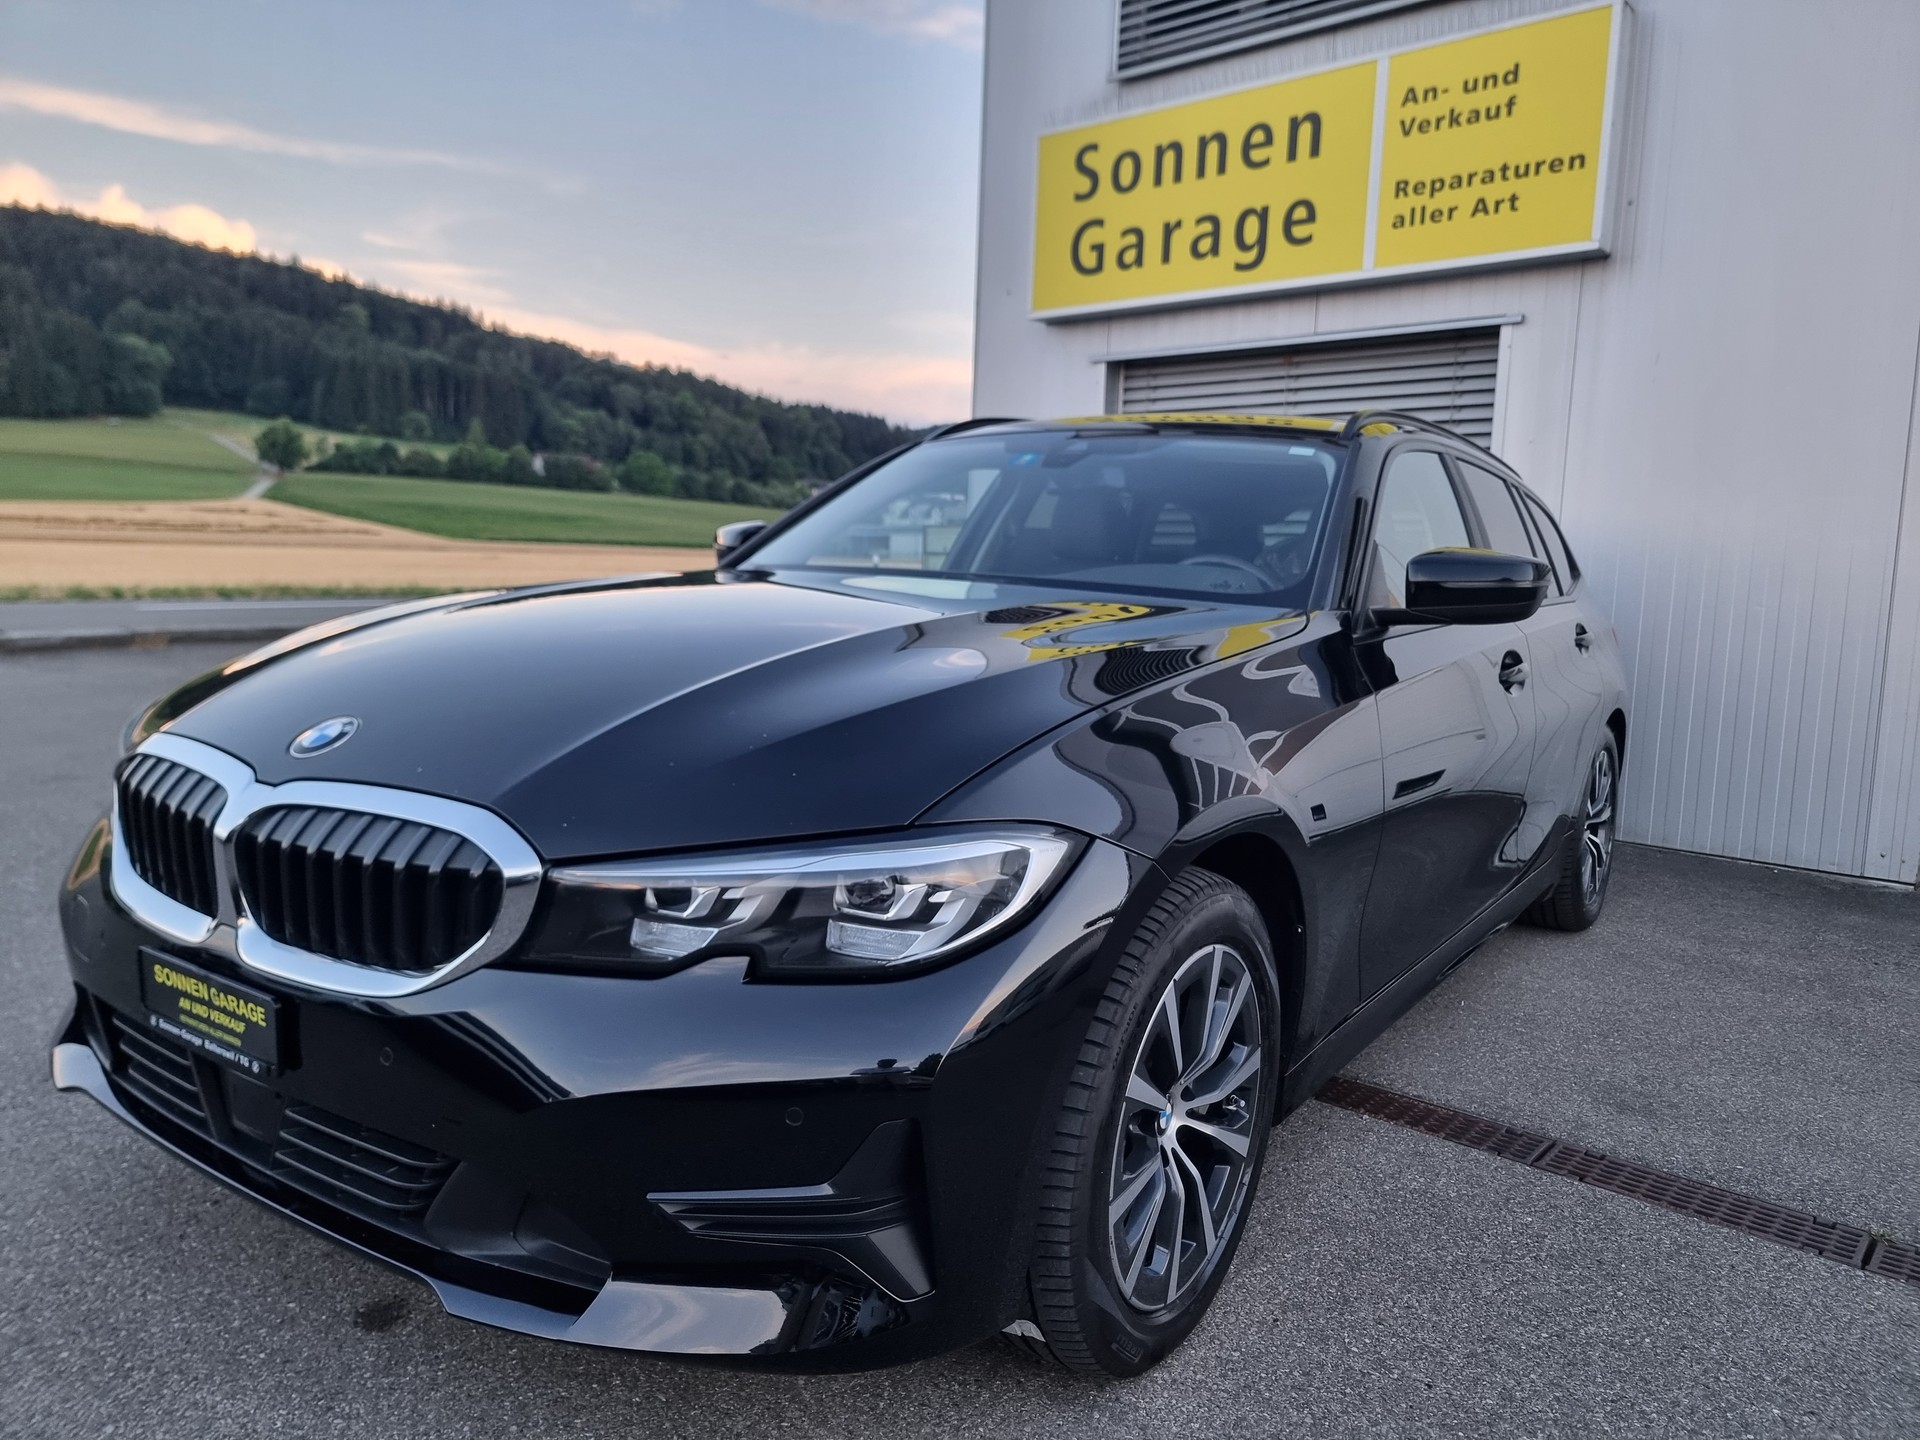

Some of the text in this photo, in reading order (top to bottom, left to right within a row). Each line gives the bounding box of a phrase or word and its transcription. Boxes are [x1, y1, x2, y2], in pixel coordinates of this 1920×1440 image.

[1400, 62, 1520, 108] An- und
[1399, 95, 1518, 138] Verkauf
[1073, 110, 1322, 202] Sonnen
[1394, 152, 1586, 199] Reparaturen
[1391, 192, 1520, 230] aller Art
[1070, 197, 1317, 276] Garage
[154, 964, 266, 1027] SONNEN GARAGE
[192, 1001, 209, 1018] UND
[210, 1008, 246, 1034] VERKAUF
